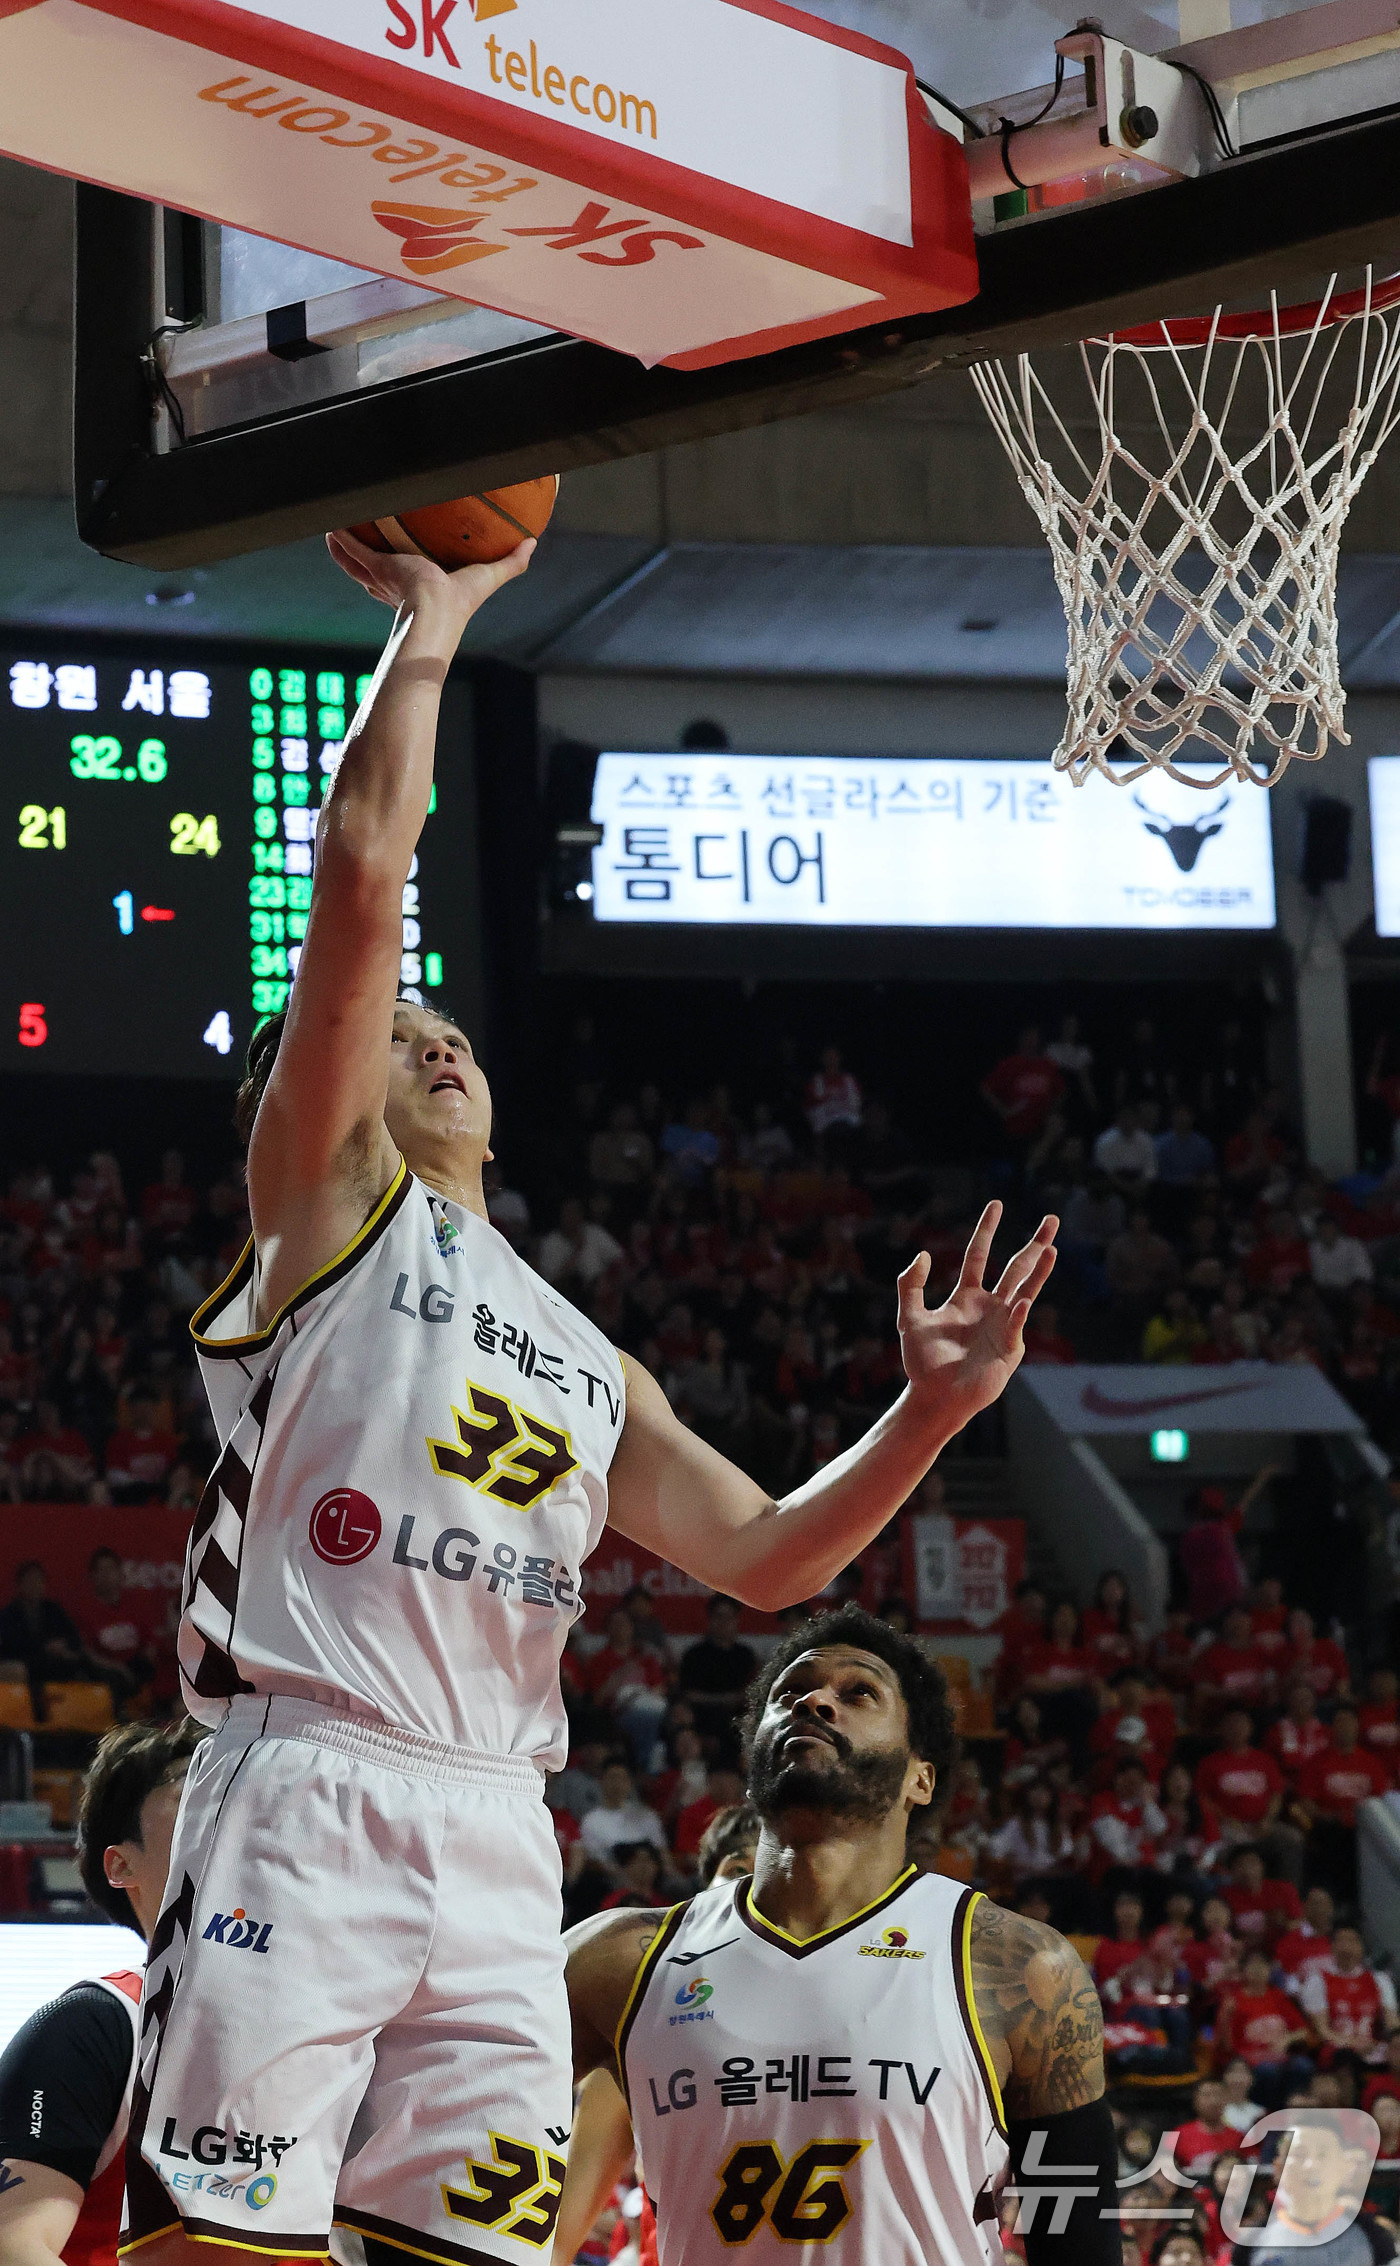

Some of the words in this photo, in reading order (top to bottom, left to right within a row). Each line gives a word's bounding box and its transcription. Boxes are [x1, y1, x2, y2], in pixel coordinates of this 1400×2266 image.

[385, 0, 461, 69] SK
[485, 34, 657, 139] telecom
[197, 76, 538, 203] telecom
[502, 201, 706, 266] SK
[122, 669, 212, 718] 서울
[70, 735, 167, 782] 32.6
[252, 737, 275, 769] 5
[618, 774, 741, 811] 스포츠
[761, 774, 964, 821] 선글라스의
[983, 778, 1059, 822] 기준
[19, 805, 67, 849] 21
[170, 813, 221, 857] 24
[614, 828, 825, 903] 톰디어
[113, 890, 134, 935] 1
[18, 1002, 48, 1047] 5
[203, 1010, 233, 1054] 4
[390, 1272, 455, 1323] LG
[472, 1303, 570, 1394] 올레드
[577, 1368, 620, 1427] TV
[425, 1377, 581, 1511] 33
[202, 1910, 273, 1953] KBL
[857, 1945, 926, 1960] SAKERS
[649, 2068, 697, 2117] LG
[714, 2055, 857, 2107] 올레드
[868, 2058, 942, 2105] TV
[29, 2089, 44, 2136] NOCTA
[440, 2130, 567, 2250] 33
[709, 2140, 873, 2247] 86
